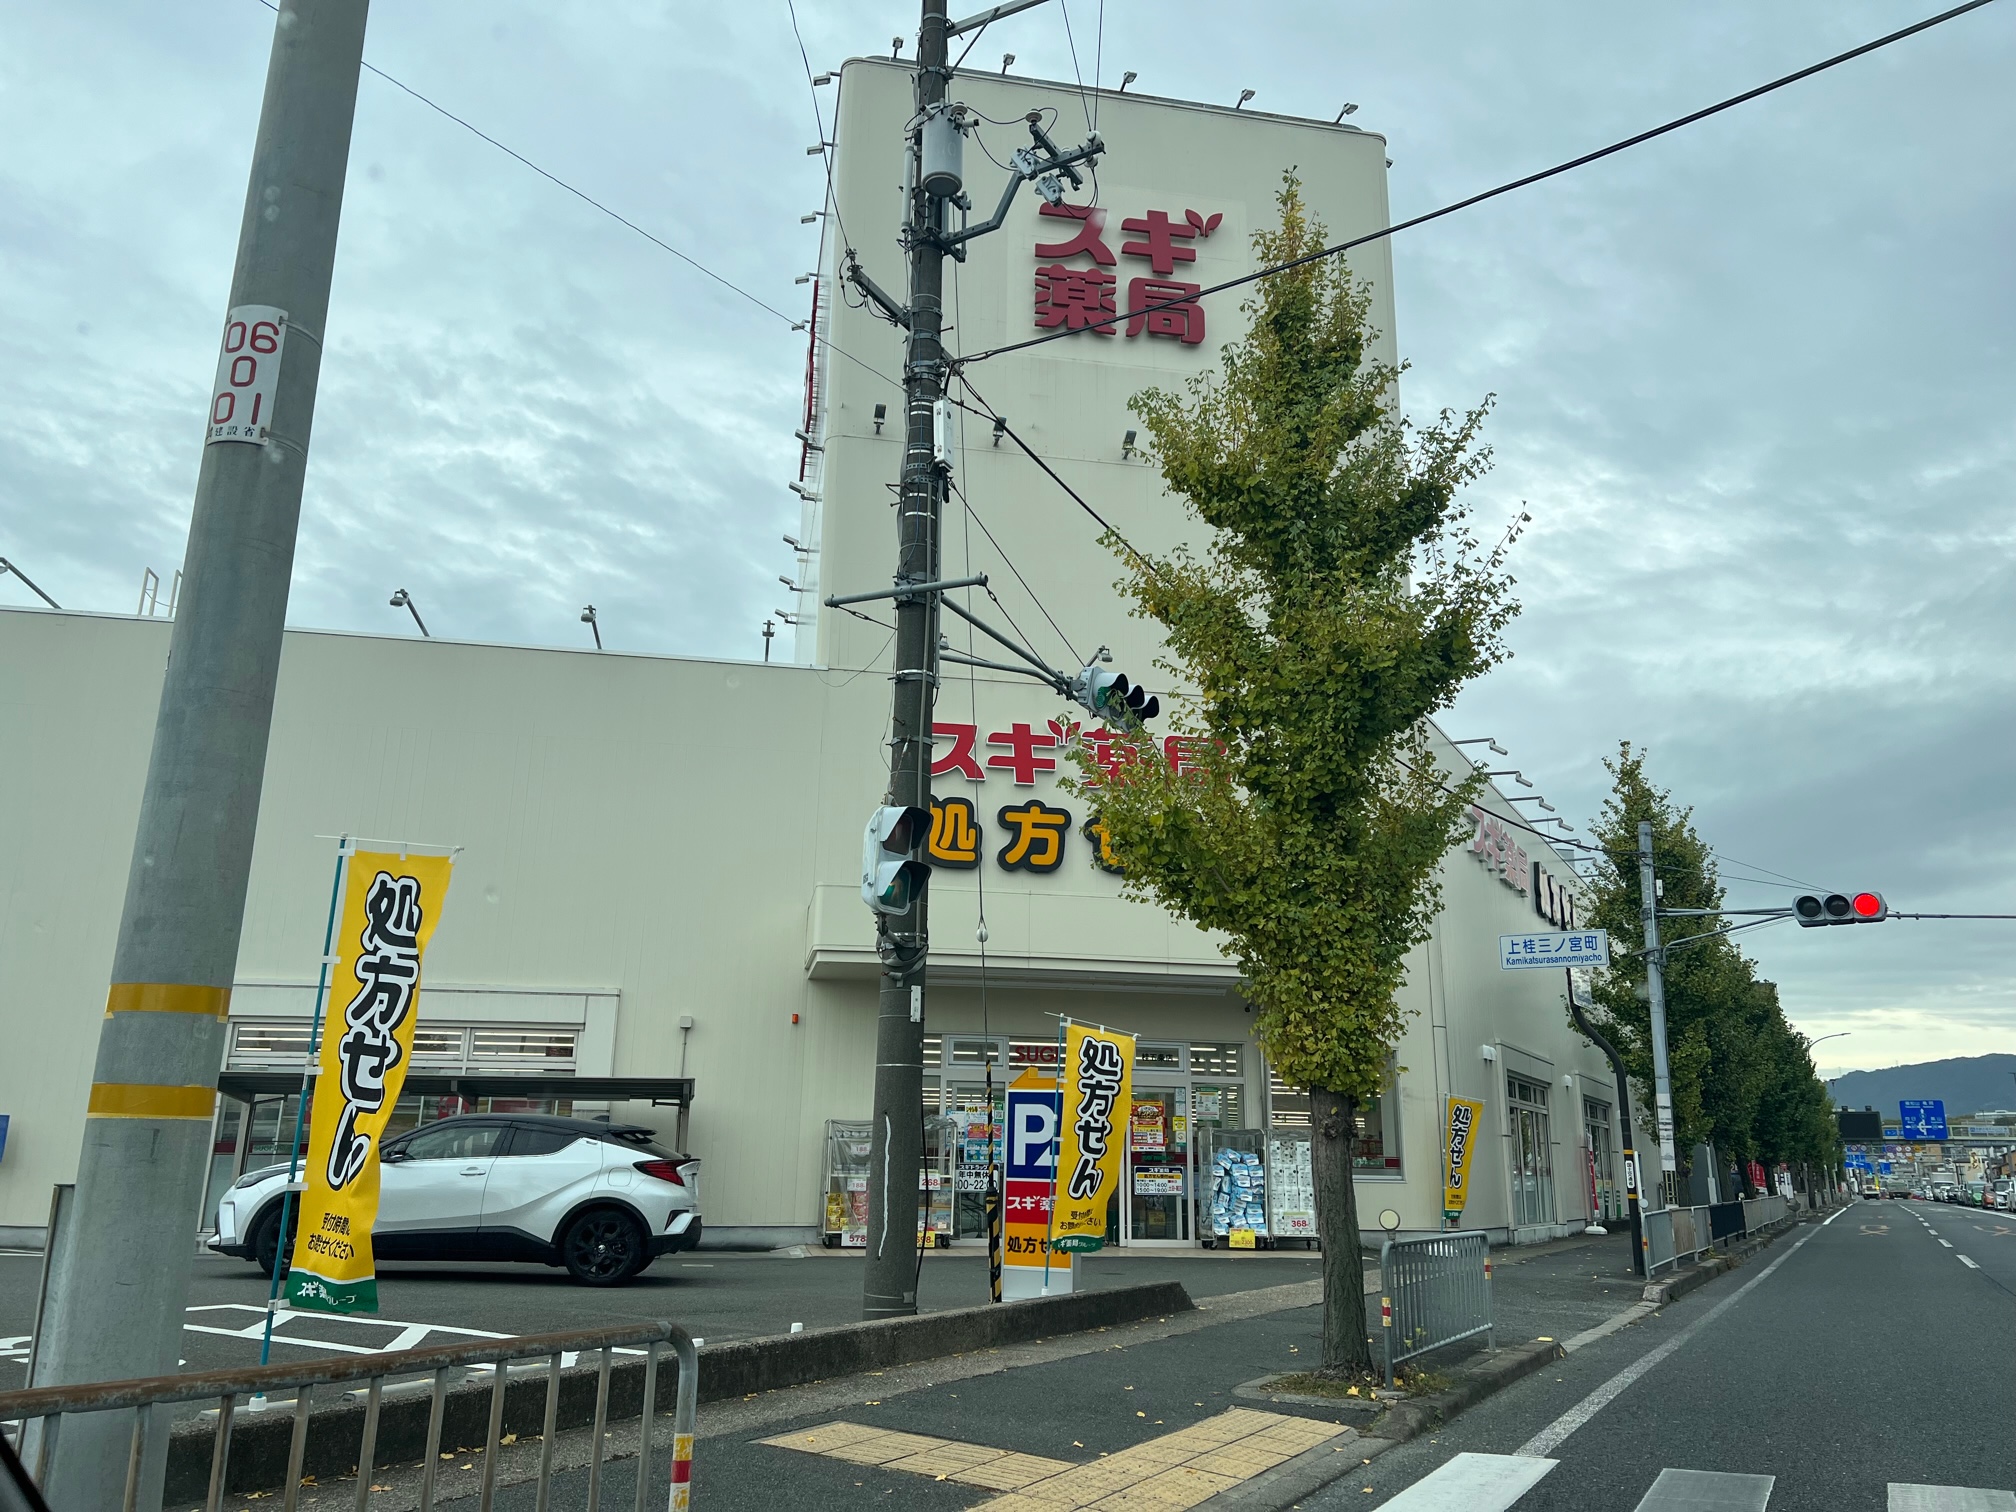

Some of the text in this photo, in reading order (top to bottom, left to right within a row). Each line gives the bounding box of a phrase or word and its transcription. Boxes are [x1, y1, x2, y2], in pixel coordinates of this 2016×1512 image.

[1034, 201, 1223, 277] スギ
[1034, 264, 1206, 345] 薬局
[225, 321, 279, 354] 06
[230, 356, 257, 387] 0
[213, 392, 262, 426] 01
[215, 426, 255, 437] 建設省
[1506, 953, 1602, 966] Kamikatsurasannomiyacho
[1508, 935, 1598, 954] 上桂三ノ宮町
[327, 870, 422, 1191] 処方せん
[1068, 1036, 1124, 1199] 処方せん
[1448, 1104, 1472, 1189] 処方せん
[959, 1170, 991, 1179] 年中無休
[849, 1234, 866, 1242] 578
[1291, 1220, 1307, 1228] 368
